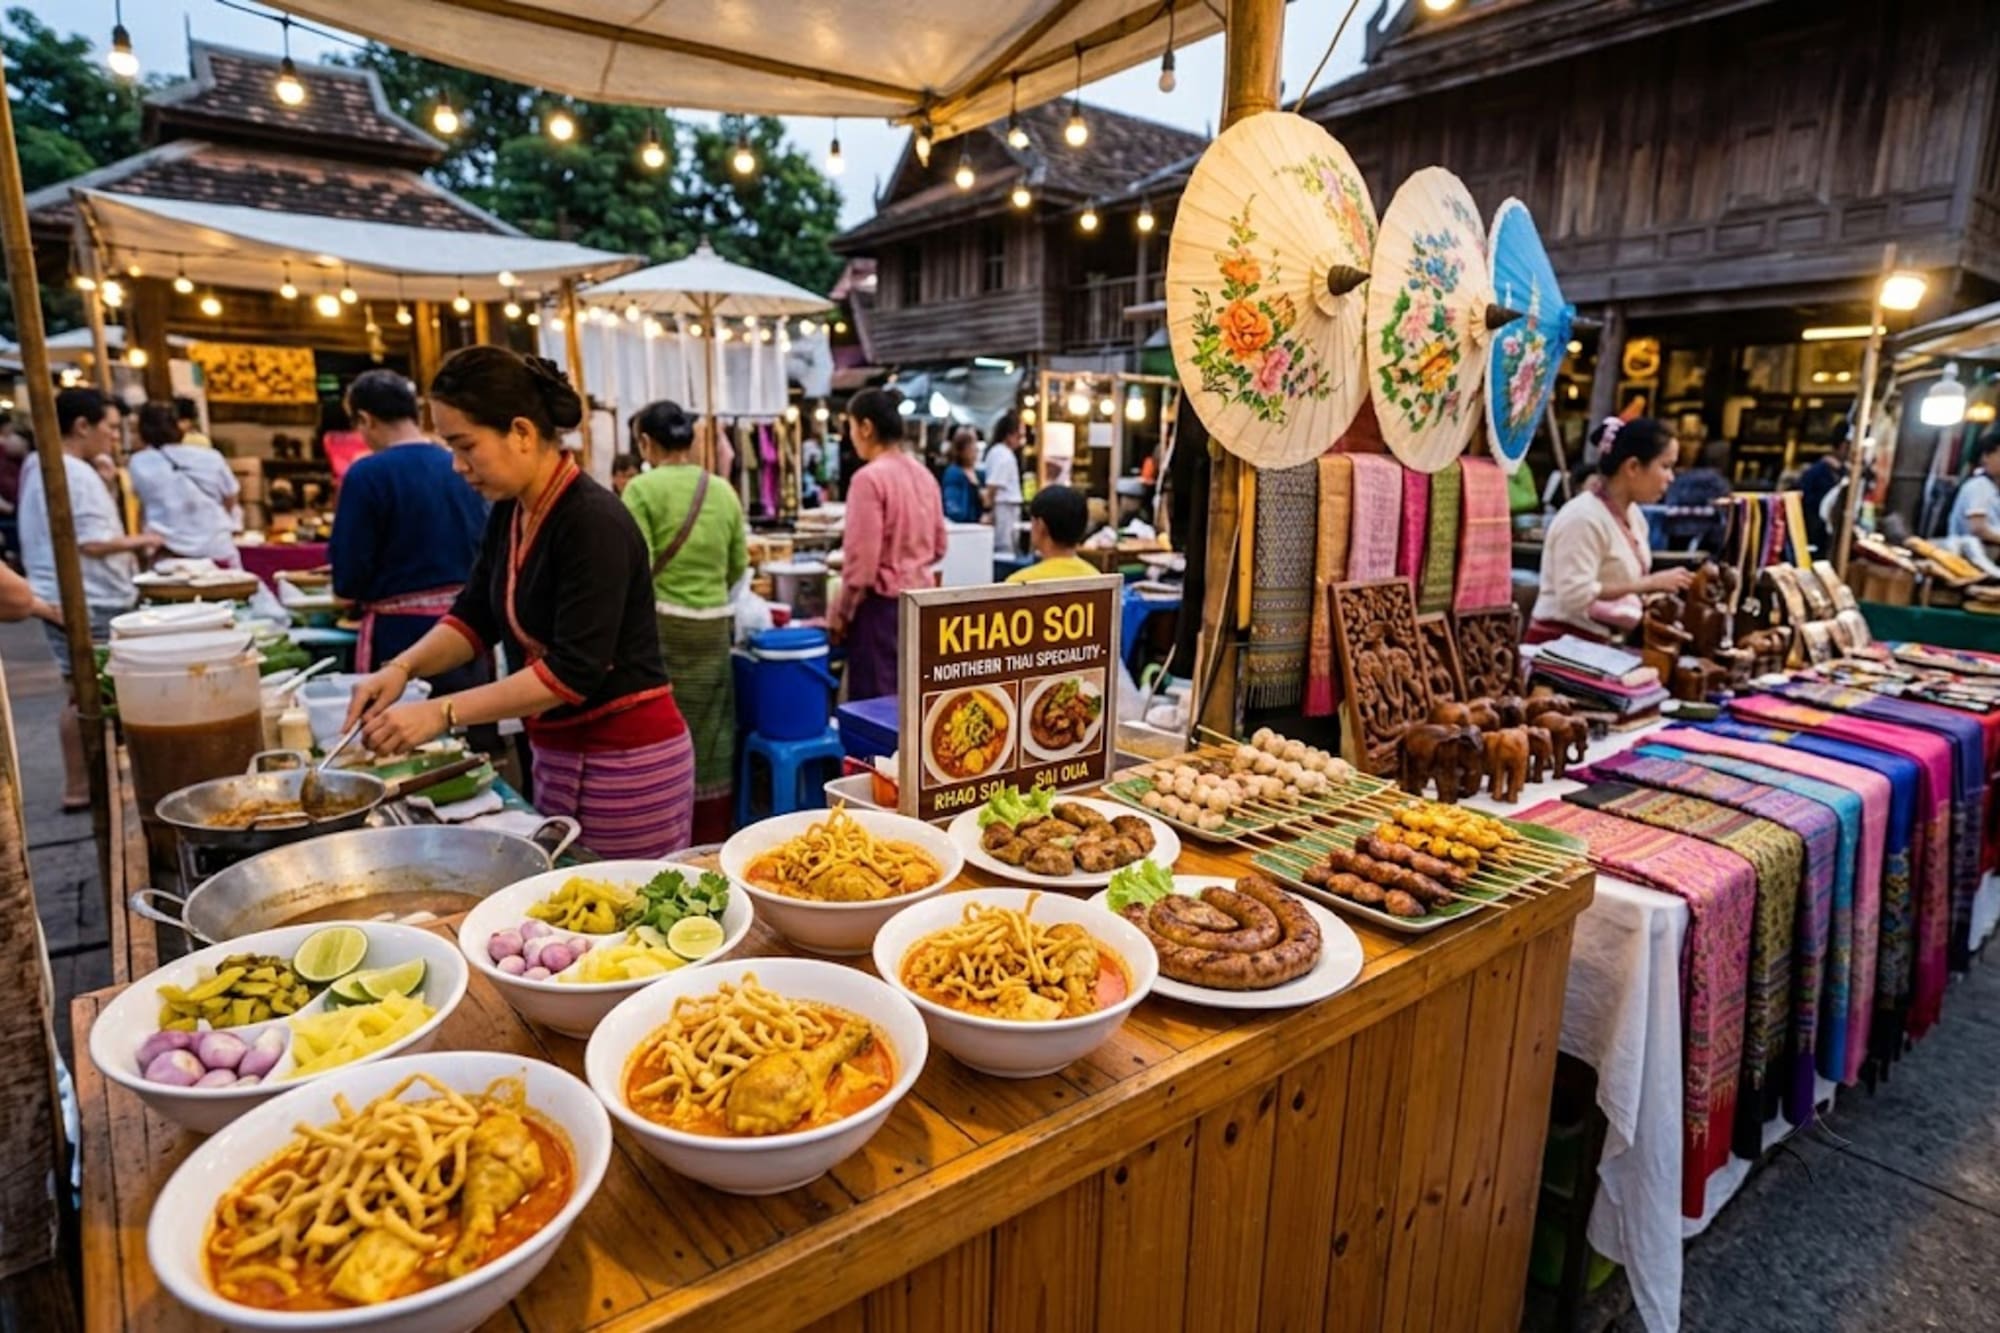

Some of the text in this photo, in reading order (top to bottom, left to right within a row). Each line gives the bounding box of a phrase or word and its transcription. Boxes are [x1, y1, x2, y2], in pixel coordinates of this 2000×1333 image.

[939, 602, 1094, 656] KHAO SOI
[1004, 653, 1034, 672] THAI
